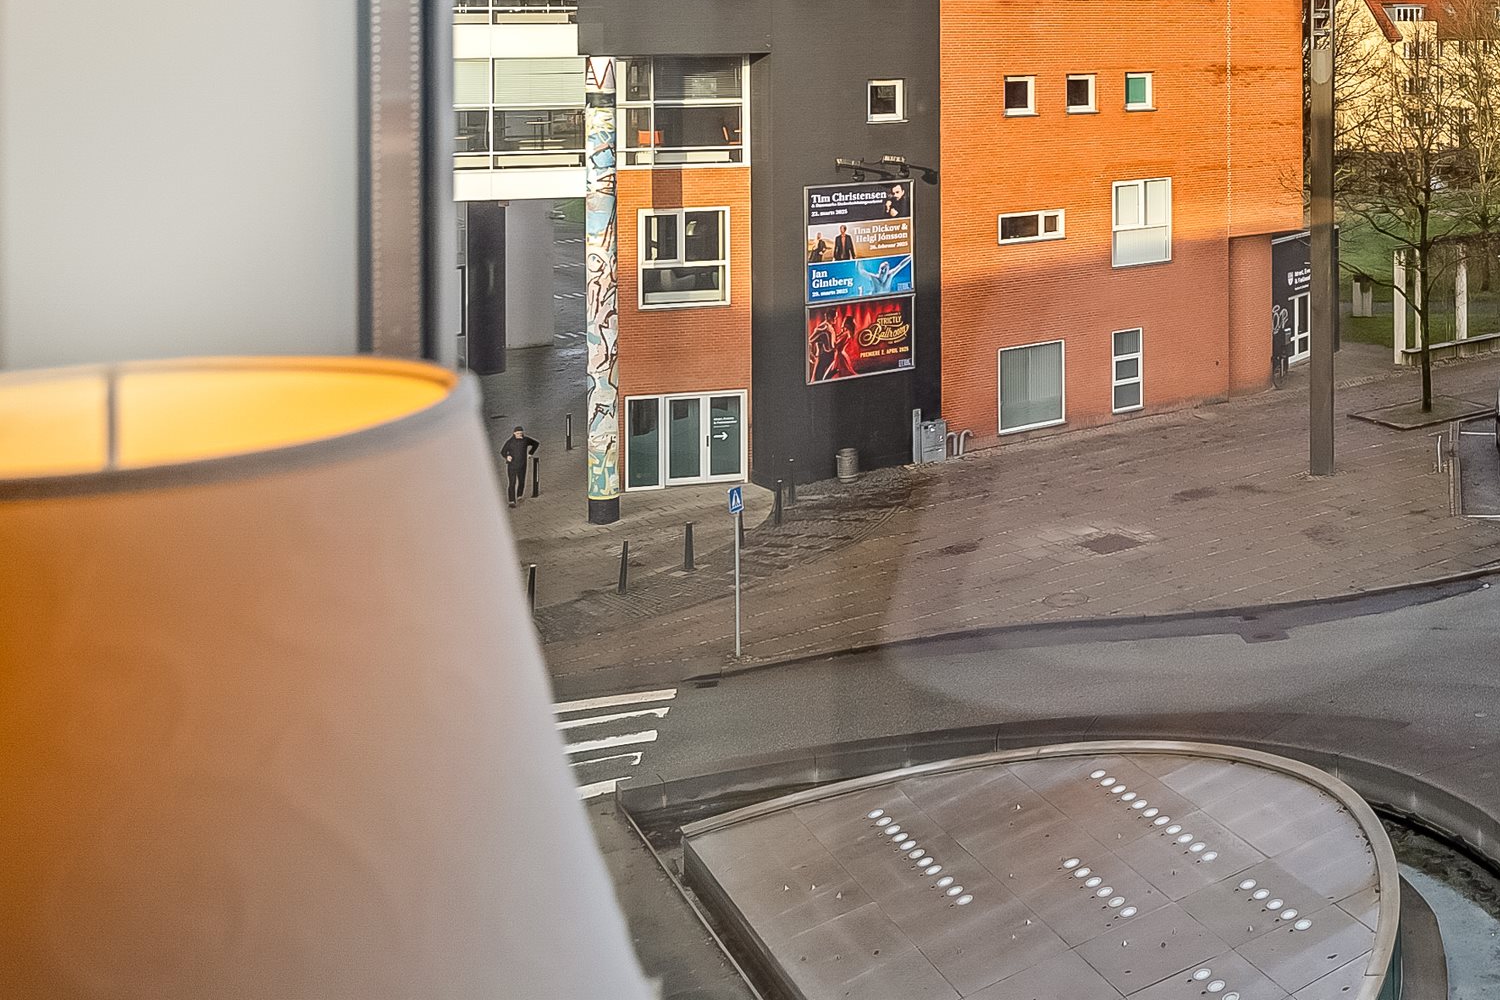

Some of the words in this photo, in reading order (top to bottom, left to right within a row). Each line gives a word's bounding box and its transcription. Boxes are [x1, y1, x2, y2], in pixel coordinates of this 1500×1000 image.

[811, 195, 831, 203] Tim
[832, 191, 887, 202] Christensen
[854, 227, 871, 235] Tina
[872, 224, 900, 233] Dickow
[856, 234, 877, 244] Helgi
[877, 232, 908, 242] Jónsson
[812, 269, 828, 279] Jan
[812, 277, 853, 288] Gintberg
[877, 316, 902, 325] STRICTLY
[858, 323, 910, 347] Ballroom
